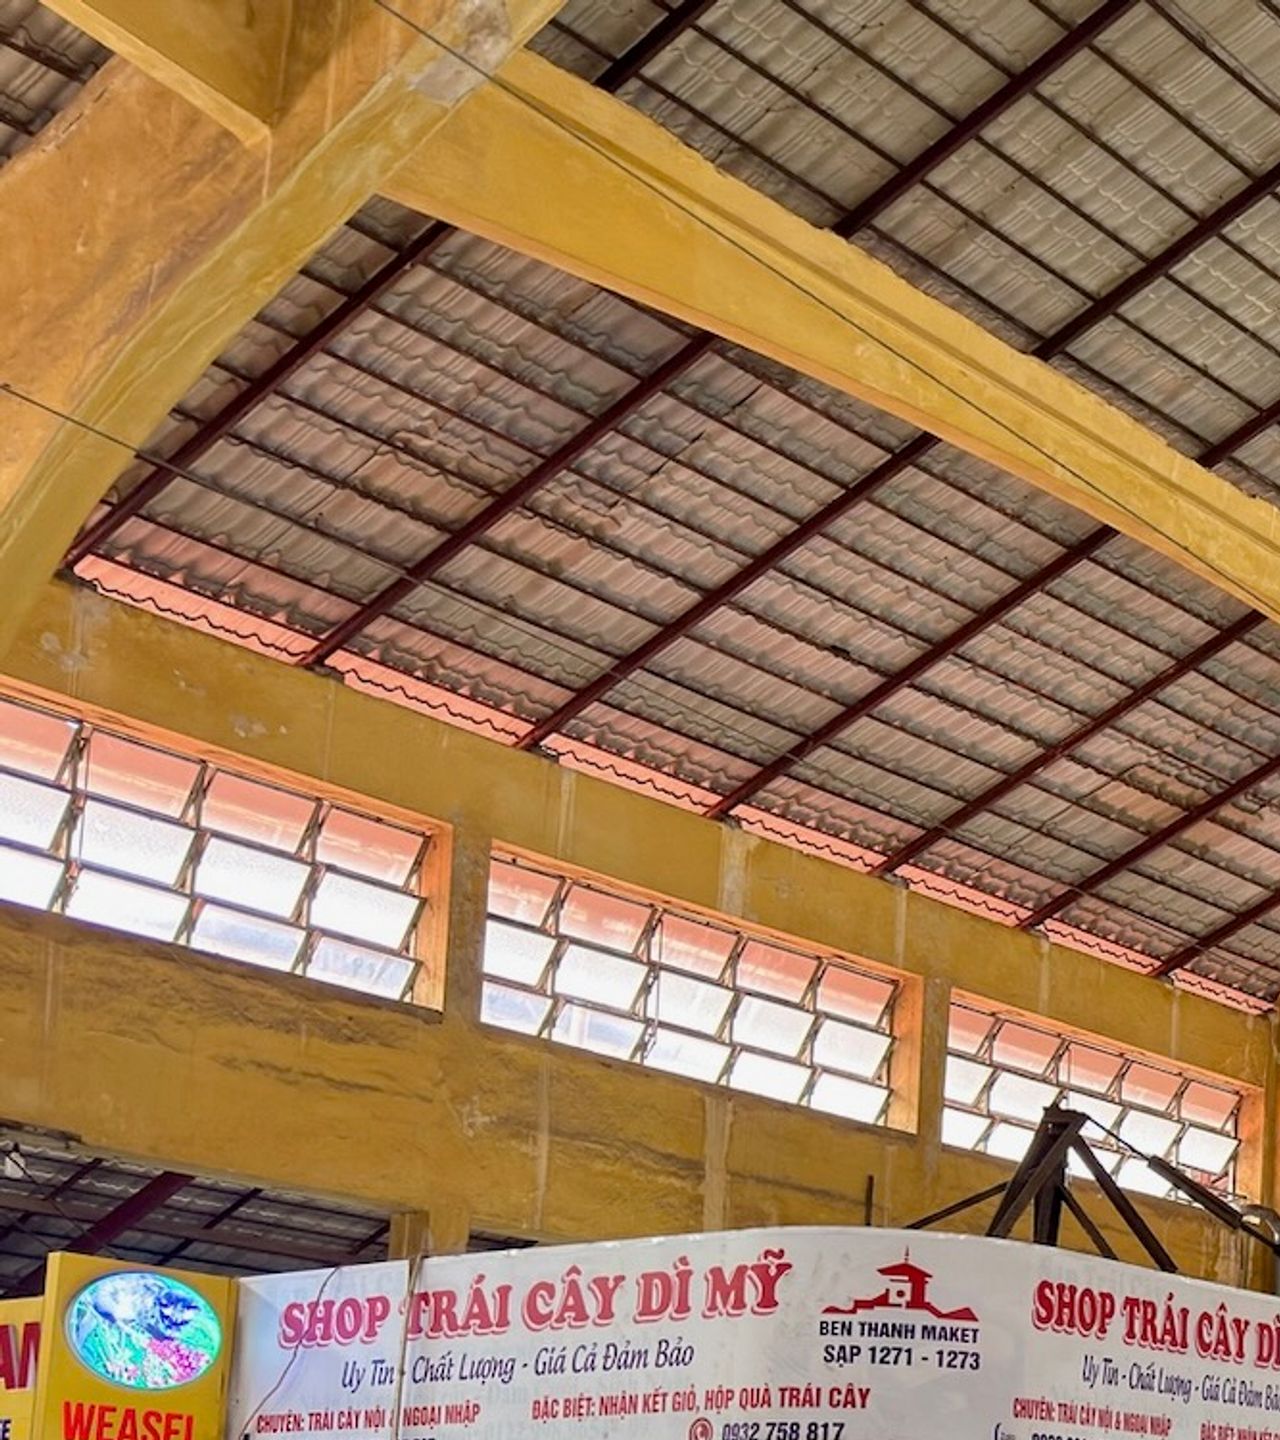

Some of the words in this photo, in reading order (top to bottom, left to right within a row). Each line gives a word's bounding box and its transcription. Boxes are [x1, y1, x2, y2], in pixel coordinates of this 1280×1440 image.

[279, 1294, 391, 1349] SHOP
[402, 1274, 512, 1341] TRÁI
[522, 1265, 626, 1332] CÂY
[633, 1256, 693, 1324] DÌ
[702, 1248, 792, 1319] MỸ
[820, 1321, 852, 1336] BEN
[859, 1322, 915, 1339] THANH
[921, 1325, 980, 1343] MAKET
[1033, 1281, 1115, 1338] SHOP
[1124, 1292, 1189, 1354] TRÁI
[1196, 1302, 1250, 1363] CÂY
[342, 1359, 366, 1393] Uy
[412, 1350, 453, 1384] Chất
[459, 1353, 516, 1387] Lượng
[535, 1346, 566, 1376] Giá
[571, 1342, 597, 1373] Cả
[602, 1339, 648, 1372] Đảm
[654, 1337, 695, 1368] Bảo
[824, 1345, 861, 1368] SẠP
[868, 1347, 912, 1366] 1271
[937, 1350, 980, 1370] 1273
[1083, 1355, 1099, 1387] Uy
[1129, 1360, 1155, 1391] Chất
[1158, 1370, 1191, 1403] Lượng
[1201, 1374, 1220, 1401] Giá
[256, 1409, 304, 1434] CHUYÊN:
[308, 1408, 334, 1431] TRÁI
[337, 1406, 361, 1430] CÂY
[364, 1403, 385, 1433] NỘI
[403, 1405, 441, 1431] NGOẠI
[445, 1401, 481, 1429] NHẬP
[532, 1397, 559, 1424] ĐẶC
[563, 1395, 595, 1422] BIỆT:
[600, 1390, 638, 1420] NHẬN
[642, 1386, 667, 1414] KẾT
[704, 1385, 734, 1415] HỘP
[739, 1383, 771, 1412] QUÀ
[779, 1383, 821, 1408] TRÁI
[829, 1383, 871, 1408] CÂY
